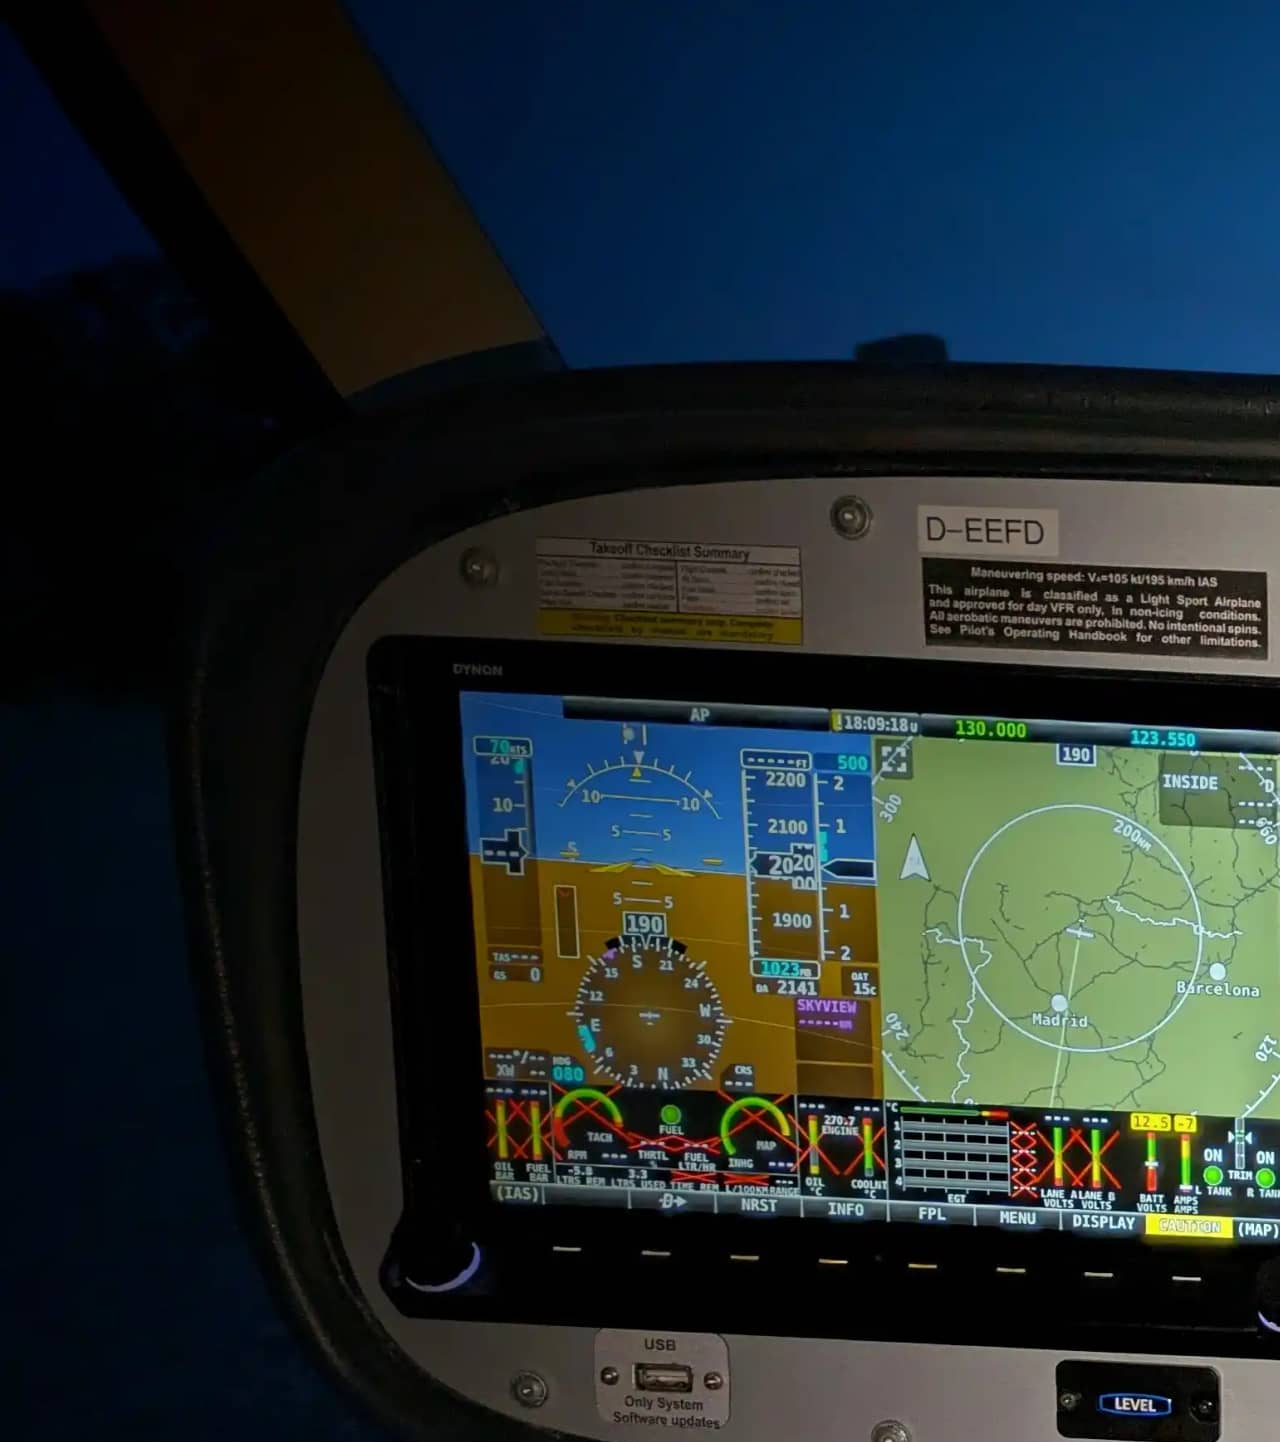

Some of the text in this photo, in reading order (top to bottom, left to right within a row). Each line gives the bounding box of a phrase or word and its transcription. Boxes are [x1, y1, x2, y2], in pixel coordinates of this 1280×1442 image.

[926, 516, 1045, 547] D-EEFD
[590, 541, 749, 562] Takeoff Checklist Summary
[930, 624, 1261, 648] See Pilot's Operating Handbook for other limitations.
[956, 720, 1196, 748] 130.000 123.550
[1163, 774, 1219, 790] INSIDE
[1177, 981, 1260, 997] Barcelona
[797, 999, 856, 1015] SKYVIEW
[1032, 1014, 1088, 1028] Madrid
[496, 1186, 539, 1202] (IAS)
[919, 1207, 1280, 1239] FPL MENU DISPLAY CAUTION (MAP)
[645, 1339, 676, 1351] USB
[625, 1396, 703, 1412] Only System
[1115, 1397, 1156, 1413] LEVEL
[614, 1412, 720, 1429] Software updates
